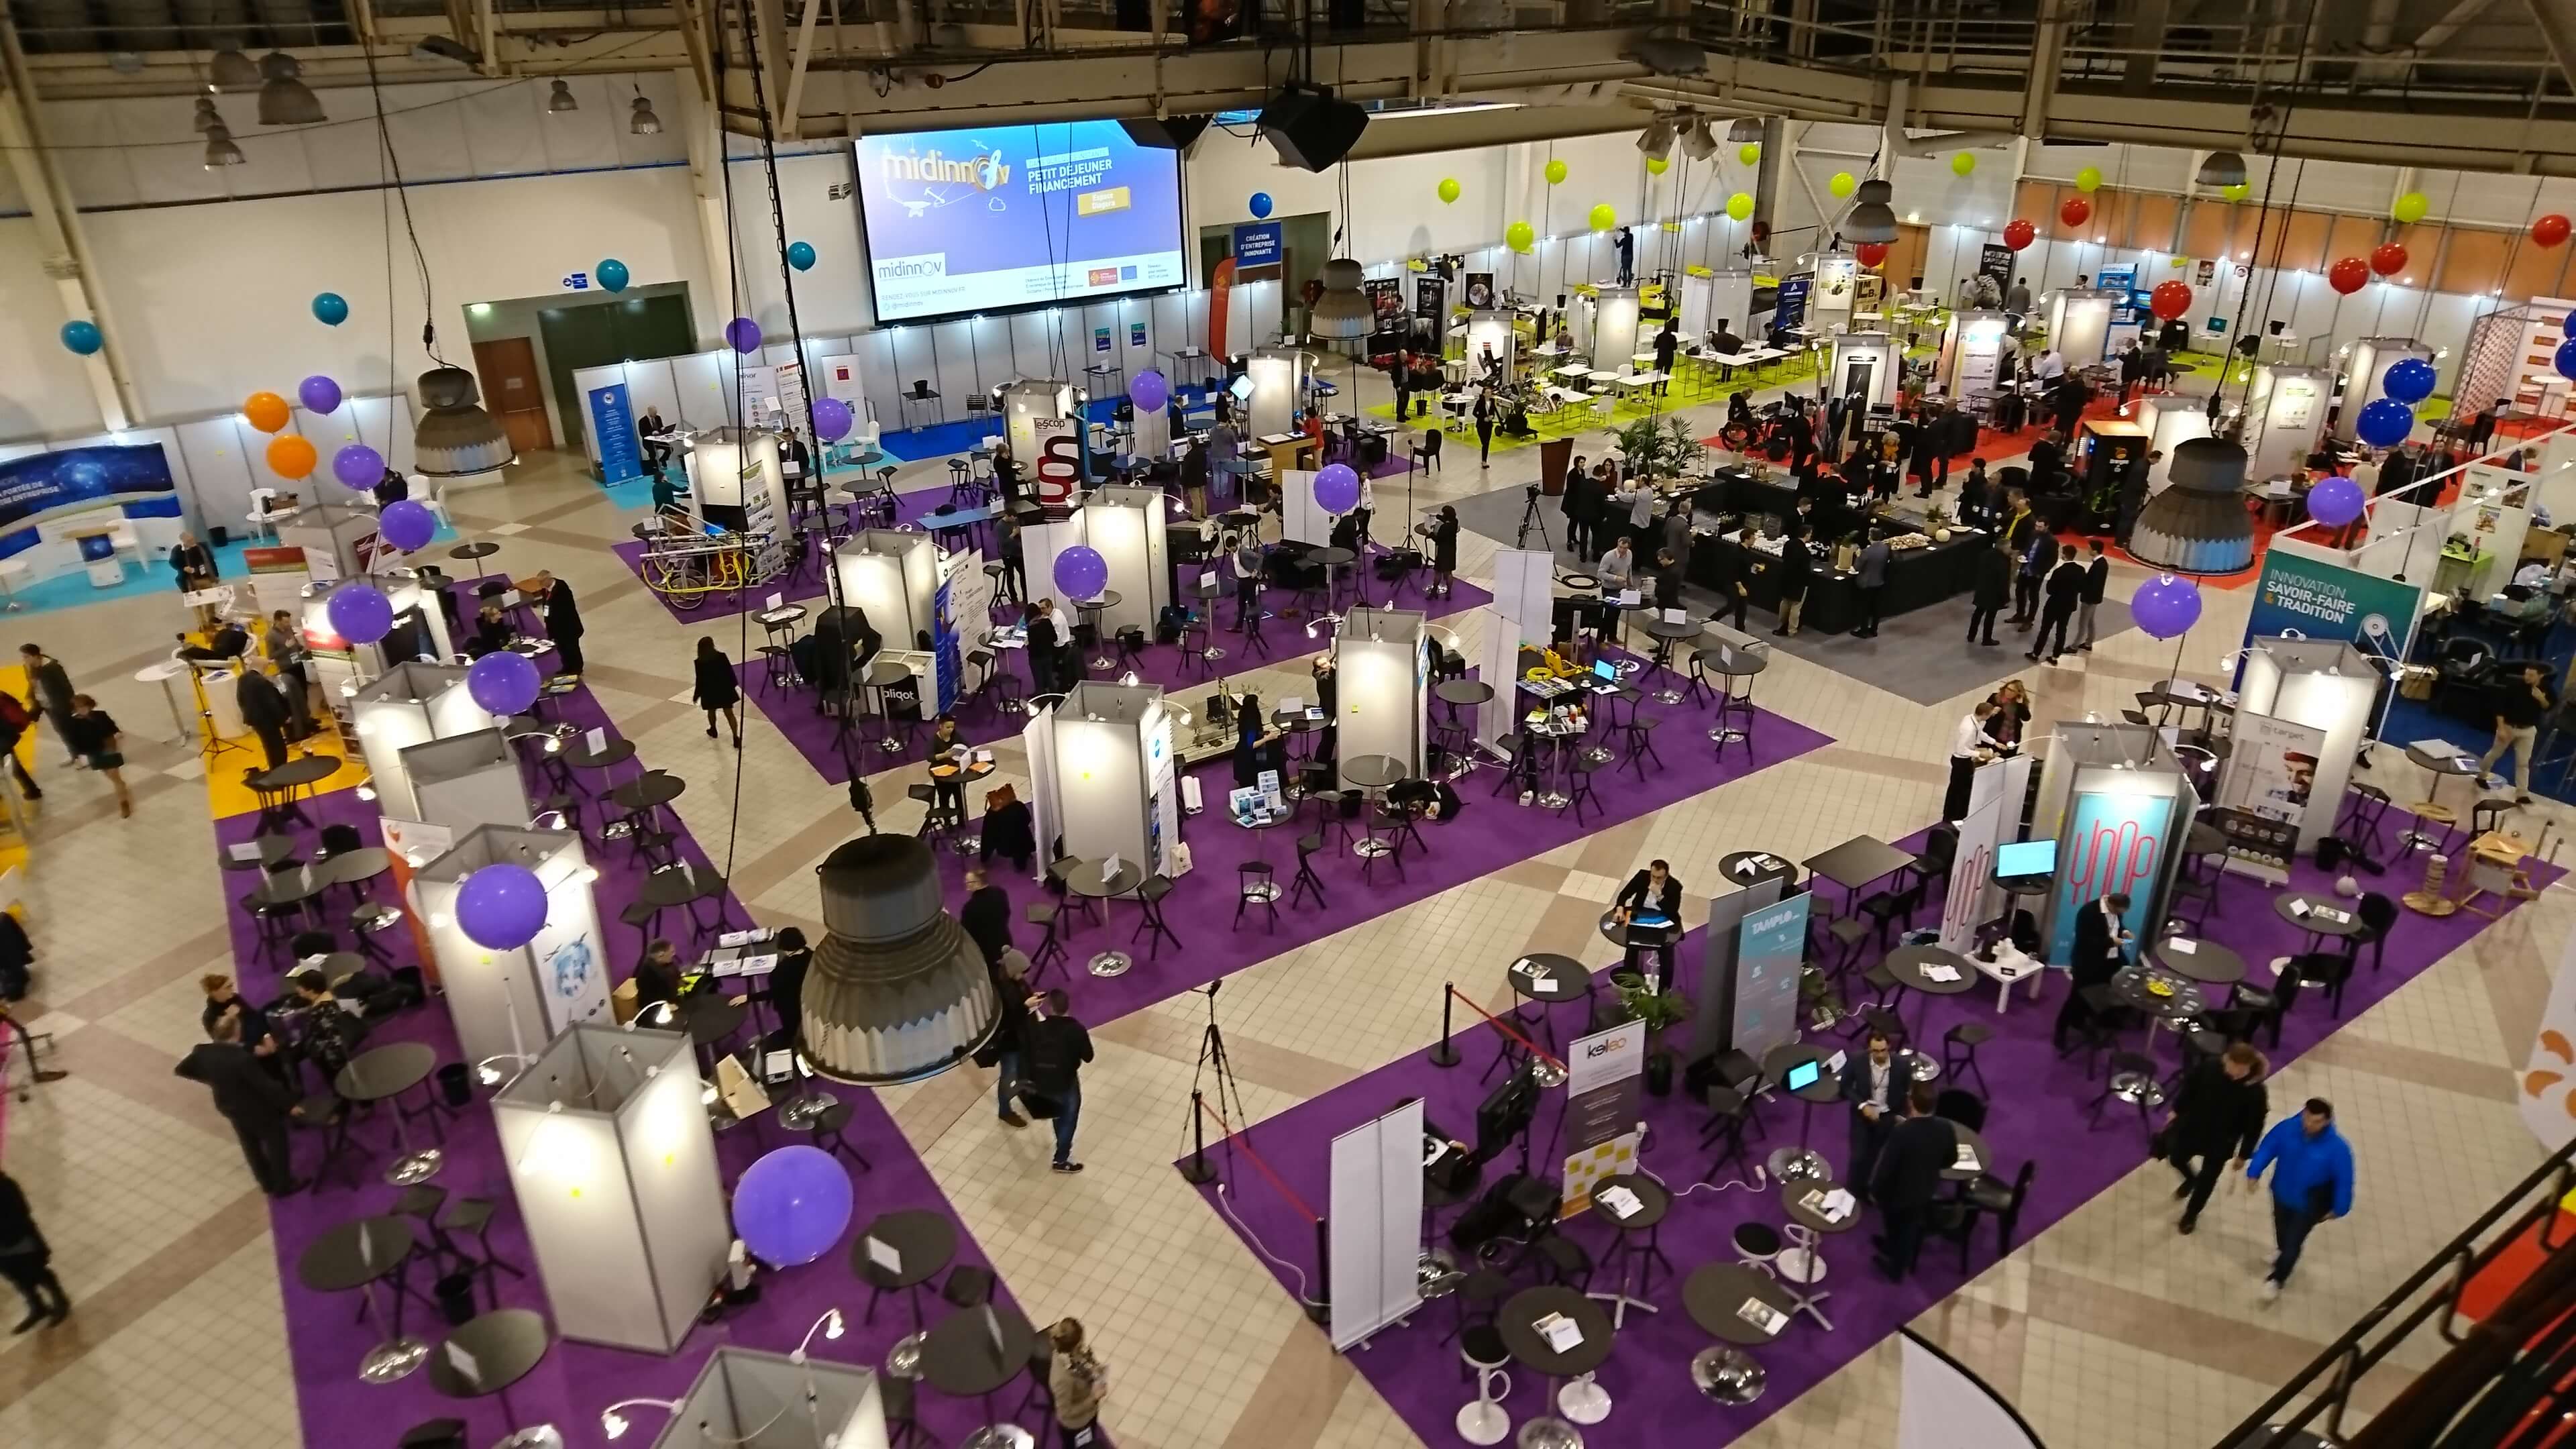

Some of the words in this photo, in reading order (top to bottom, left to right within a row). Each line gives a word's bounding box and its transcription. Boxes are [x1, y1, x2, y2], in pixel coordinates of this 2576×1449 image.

[1028, 167, 1057, 182] PETIT
[1059, 159, 1112, 177] DÉJEUNER
[1029, 172, 1102, 195] FINANCEMENT
[1240, 240, 1275, 250] D'ENTREPRISE
[1246, 232, 1270, 241] CRÉATION
[1244, 248, 1272, 258] INNOVANTE
[878, 261, 942, 278] midinnov
[2270, 569, 2347, 598] INNOVATION
[2264, 592, 2274, 604] &
[2277, 595, 2345, 624] TRADITION
[2266, 581, 2356, 614] SAVOIR-FAIRE
